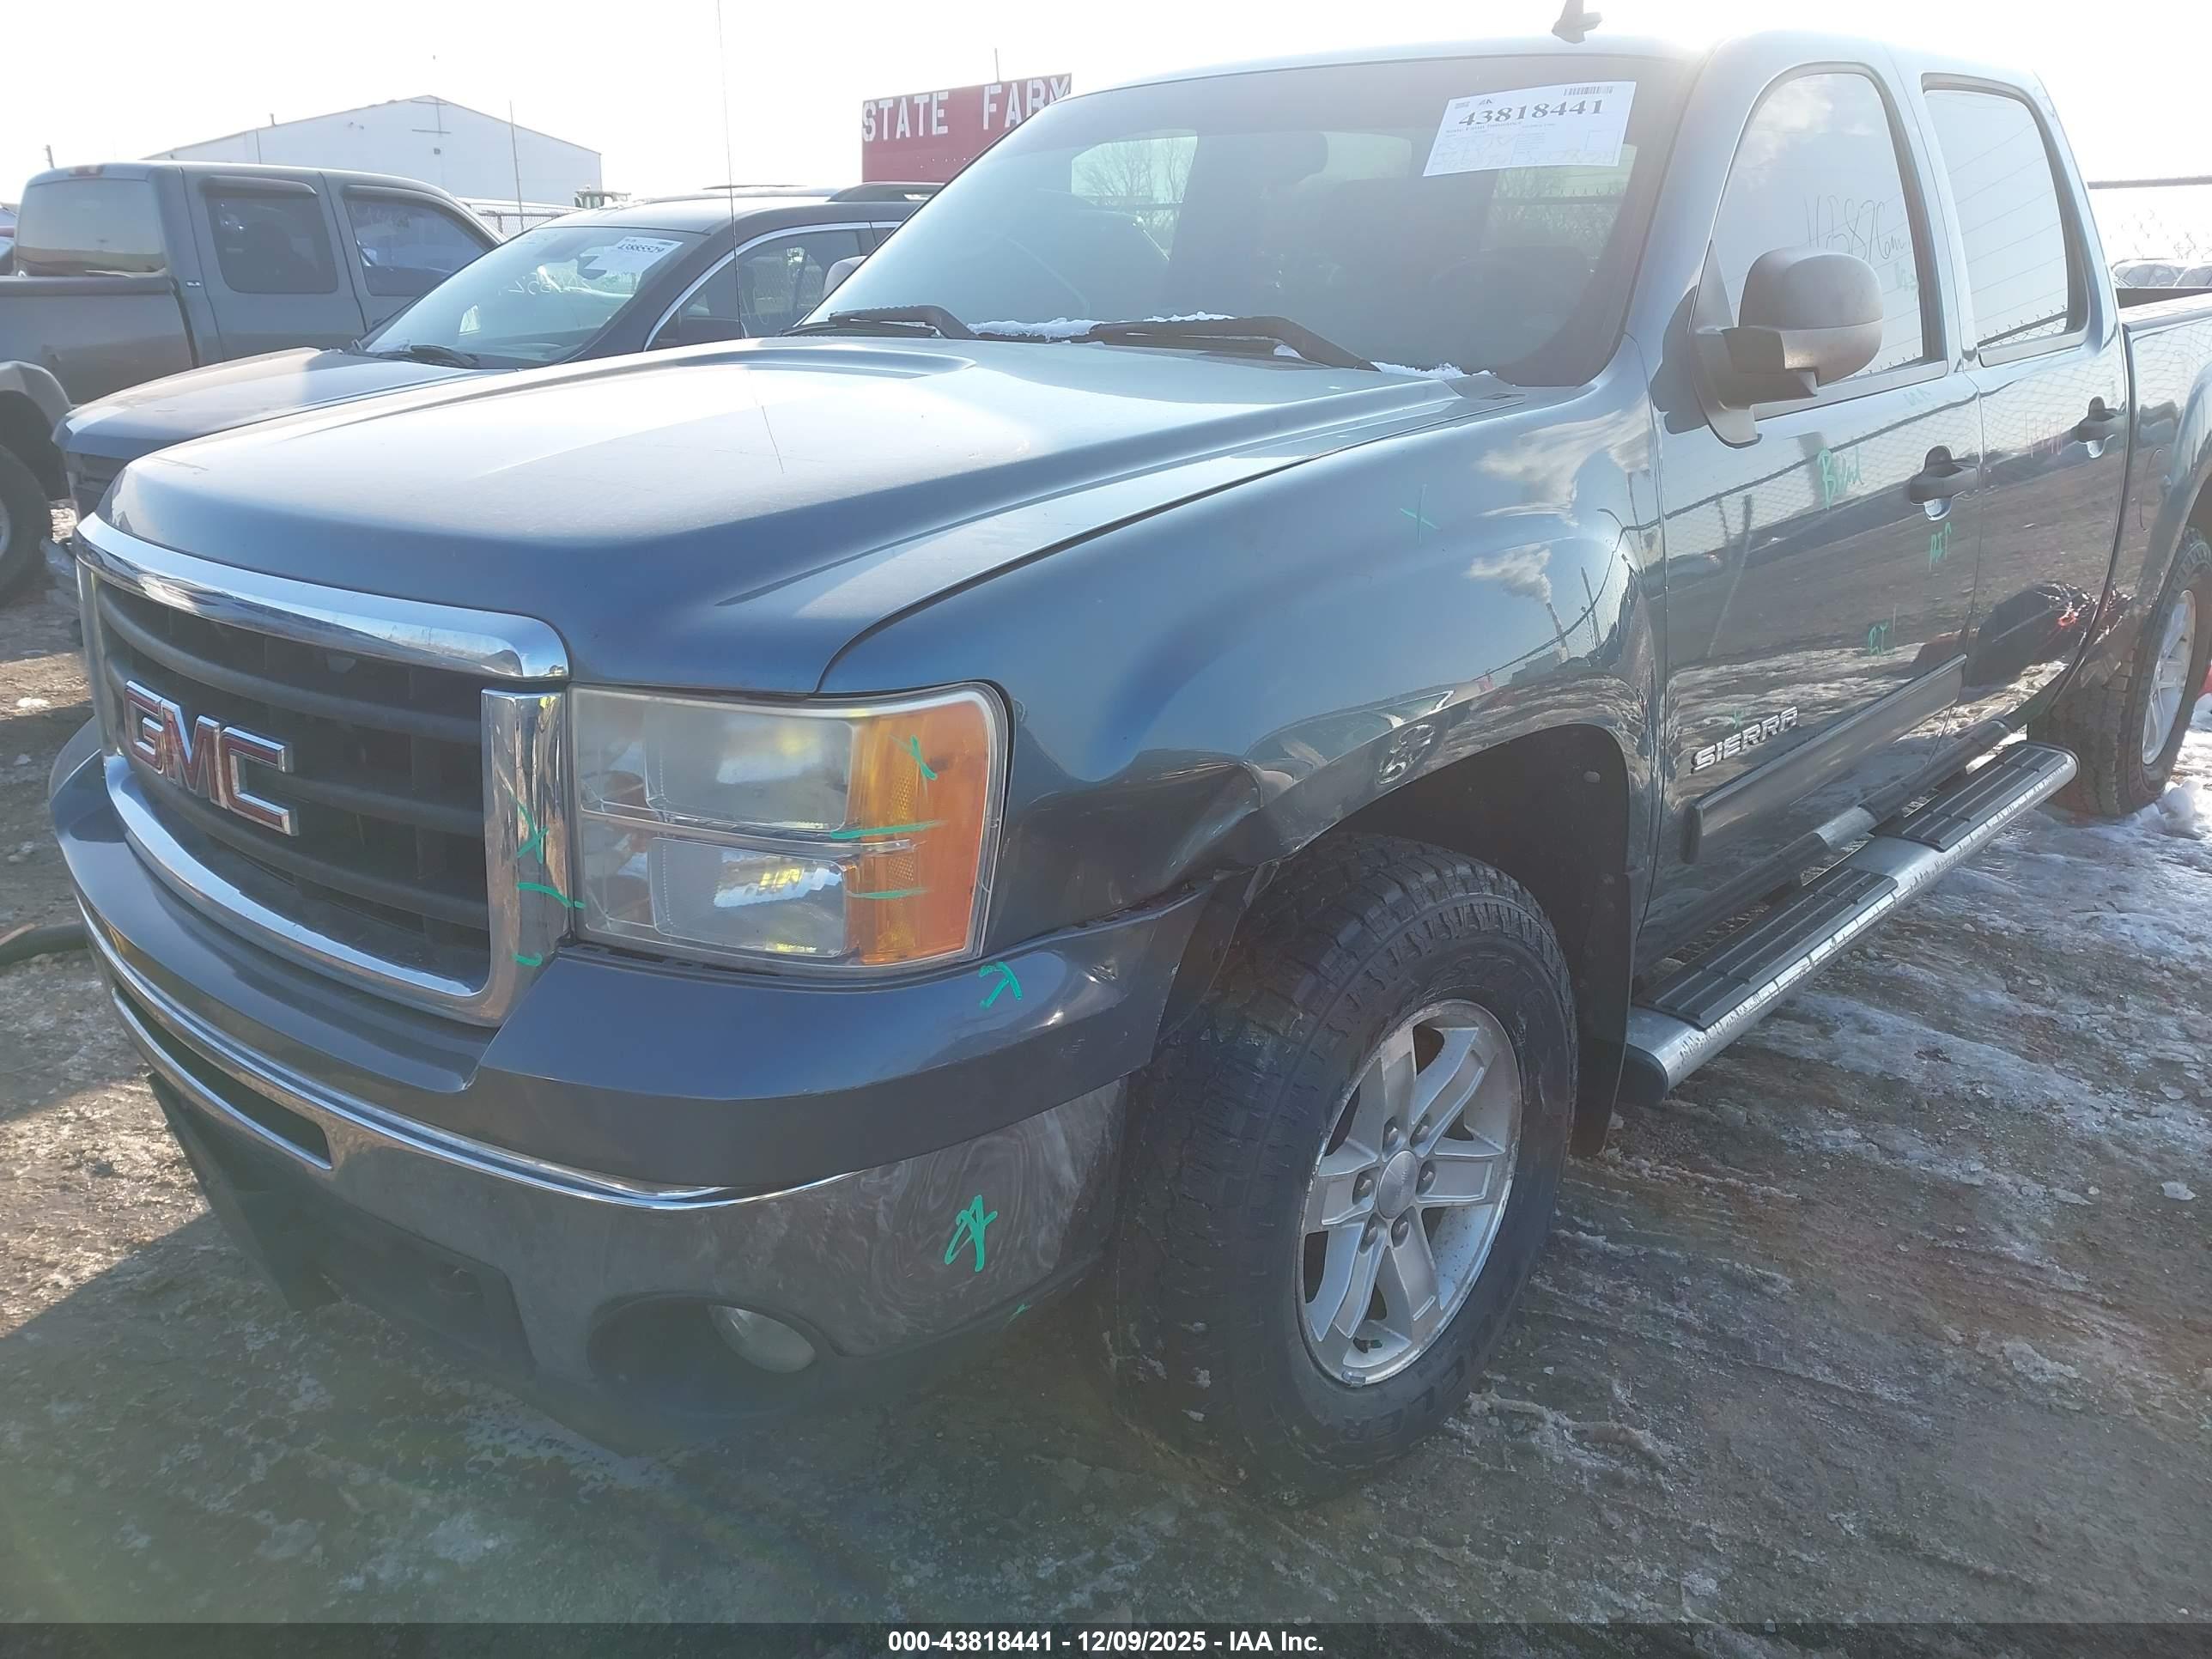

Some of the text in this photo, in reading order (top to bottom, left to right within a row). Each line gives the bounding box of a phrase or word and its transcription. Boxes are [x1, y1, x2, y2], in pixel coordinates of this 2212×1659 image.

[862, 90, 949, 142] STATE
[1459, 99, 1603, 126] 43818441
[124, 680, 299, 836] GMC
[1691, 706, 1799, 775] SIERRA
